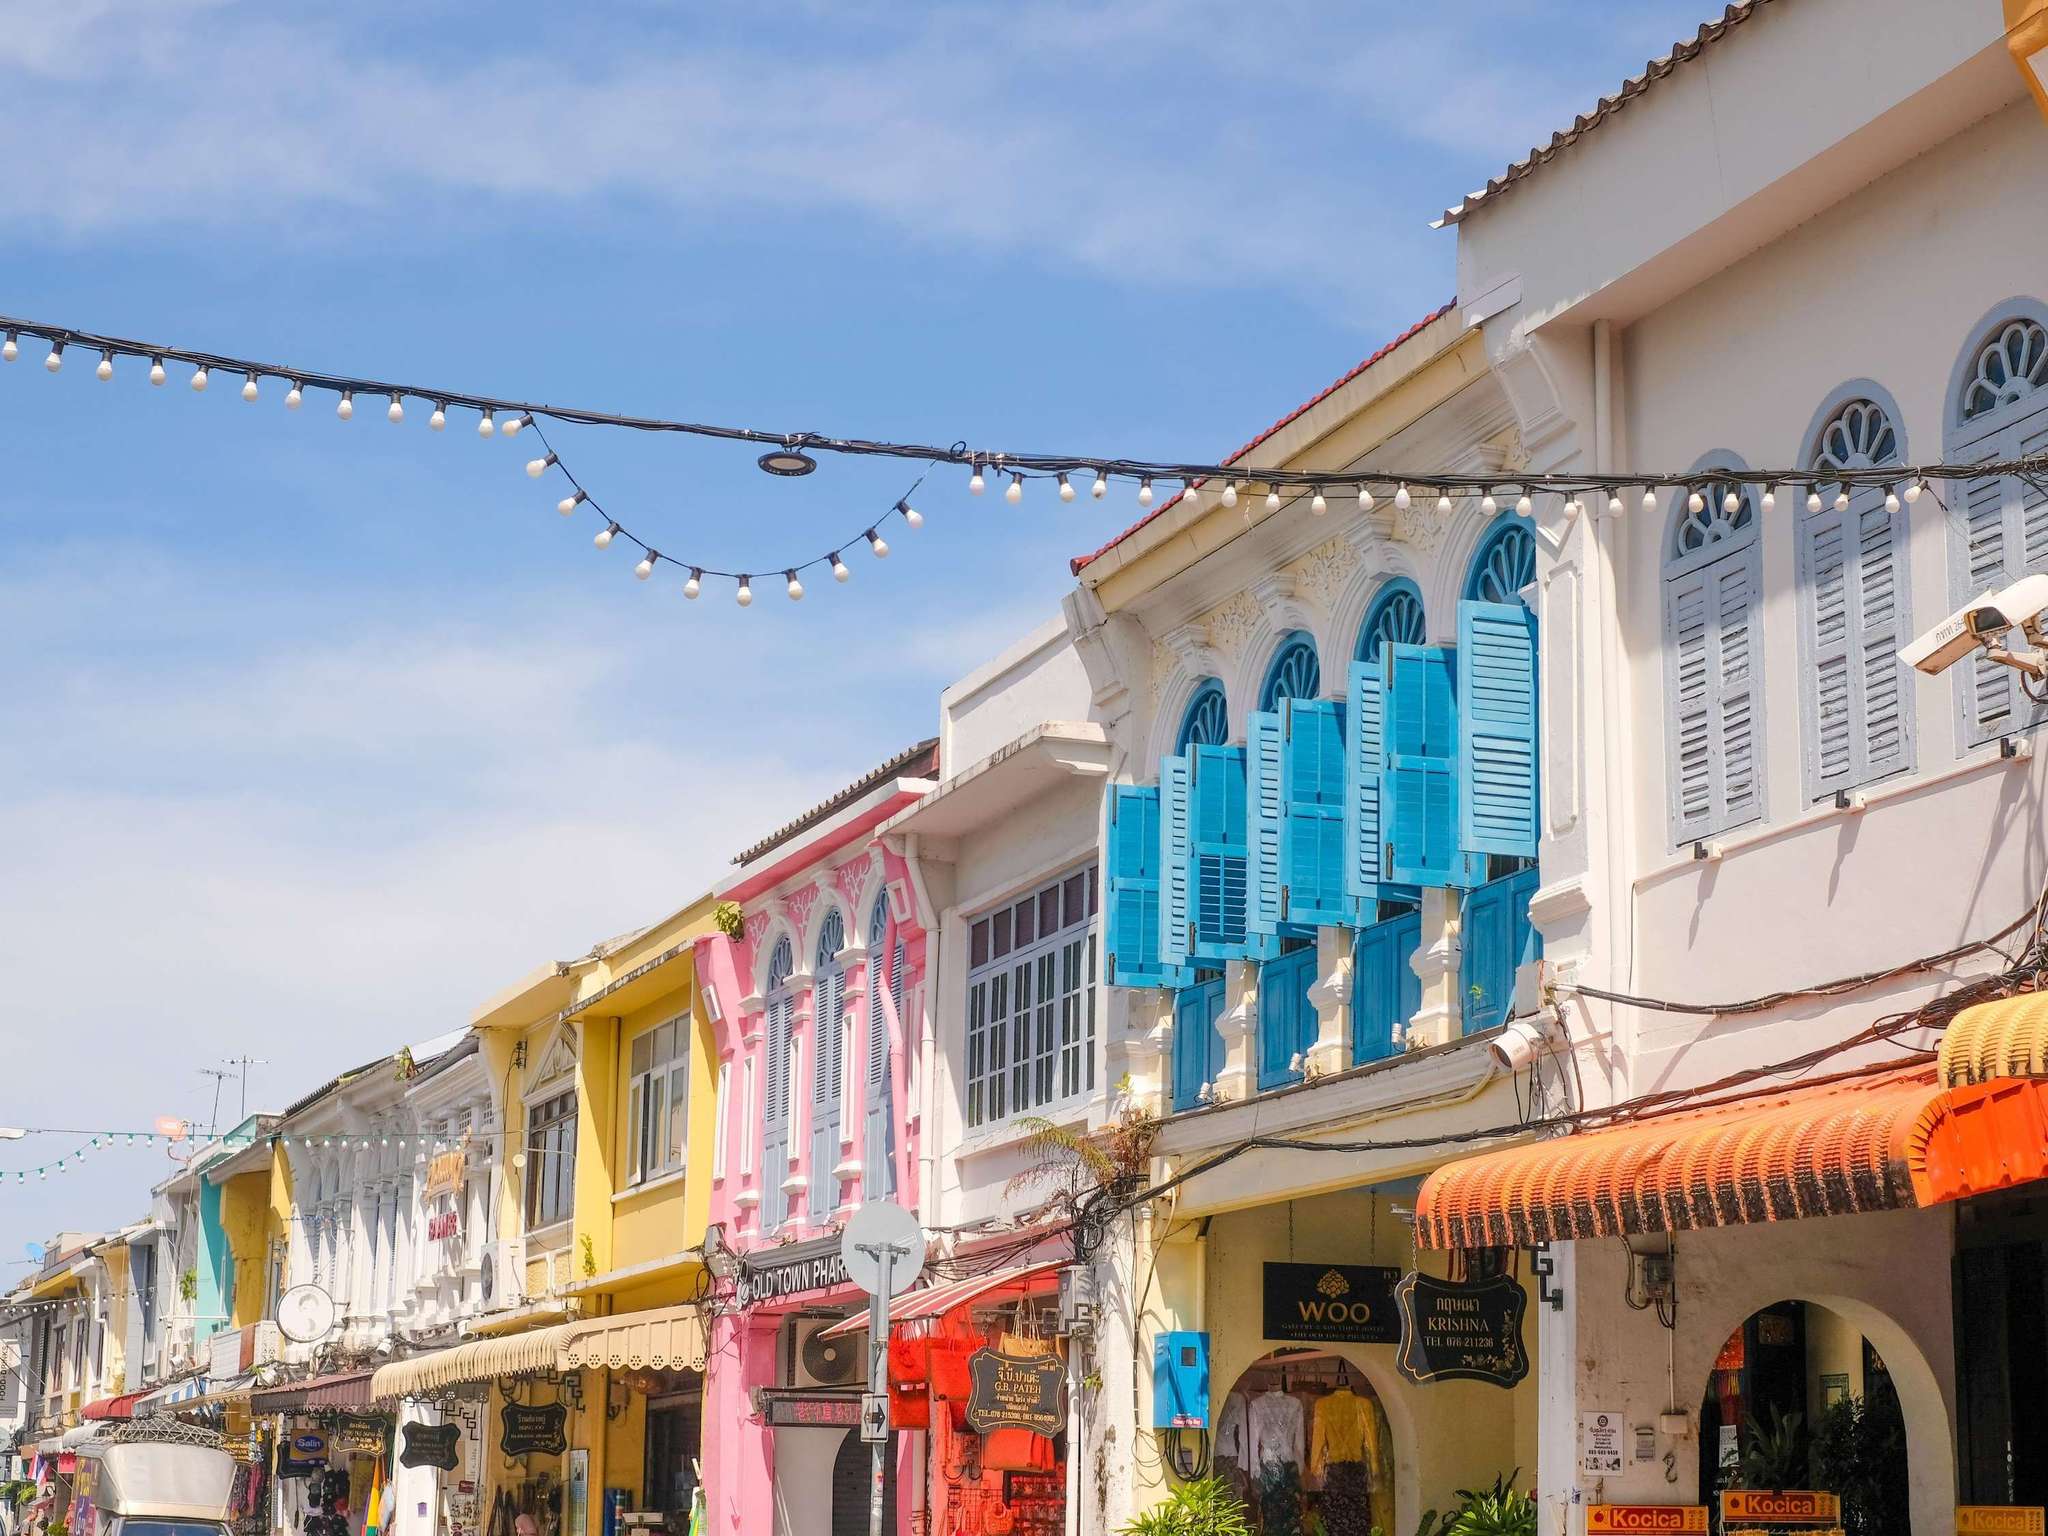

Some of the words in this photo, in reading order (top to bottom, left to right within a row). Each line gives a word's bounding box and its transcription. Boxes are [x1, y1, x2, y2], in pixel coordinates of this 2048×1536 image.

[752, 1272, 773, 1300] OLD
[777, 1262, 809, 1295] TOWN
[1298, 1301, 1371, 1324] WOO
[1436, 1298, 1480, 1314] กฤษณา
[1428, 1316, 1489, 1332] KRISHNA
[994, 1381, 1011, 1392] G.B.
[297, 1438, 321, 1448] Salin
[1748, 1495, 1812, 1513] Kocica
[1613, 1508, 1681, 1528] Kocica
[1975, 1511, 2024, 1529] Kocica
